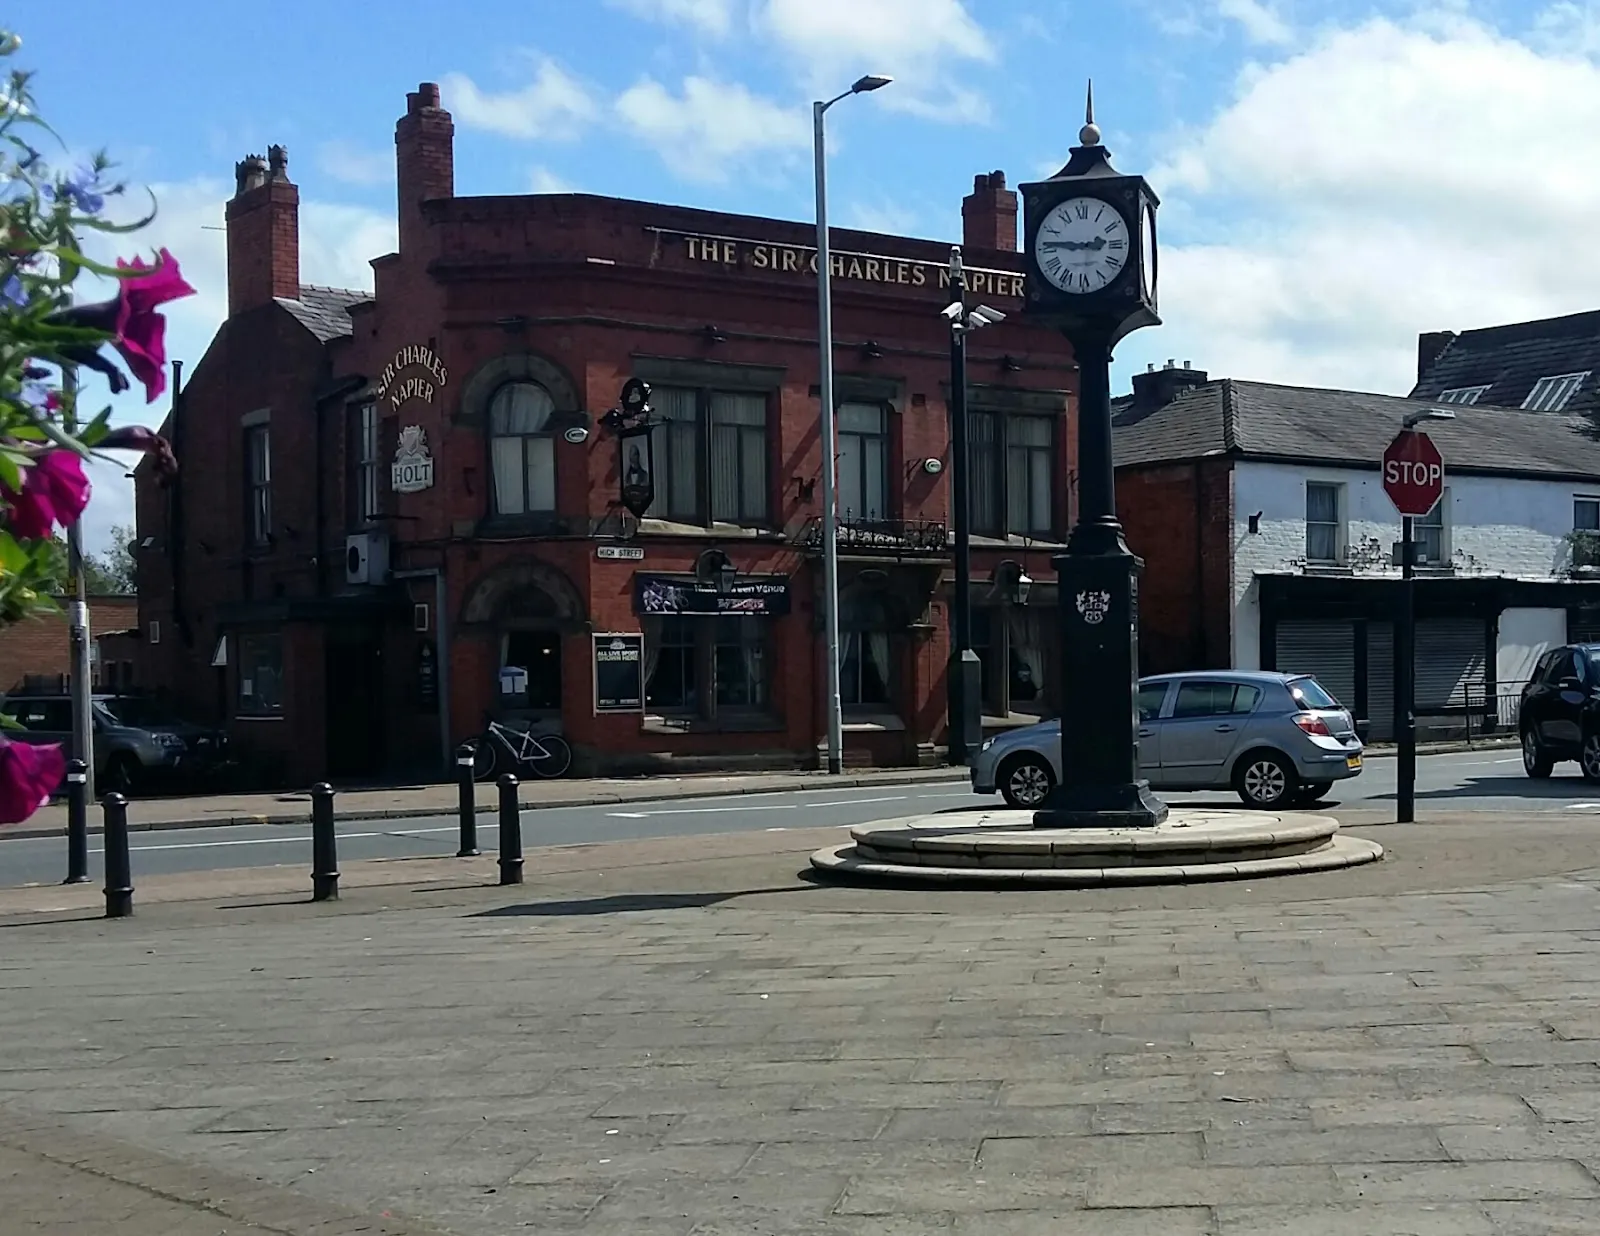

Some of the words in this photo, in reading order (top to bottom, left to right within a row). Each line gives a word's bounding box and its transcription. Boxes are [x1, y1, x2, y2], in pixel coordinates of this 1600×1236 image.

[684, 236, 737, 264] THE
[754, 245, 798, 272] SIR
[378, 363, 396, 400] SIR
[395, 344, 448, 386] CHARLES
[391, 377, 434, 412] NAPIER
[394, 464, 430, 484] HOLT
[1386, 460, 1441, 487] STOP
[600, 549, 615, 557] HIGH
[619, 549, 642, 558] STREET
